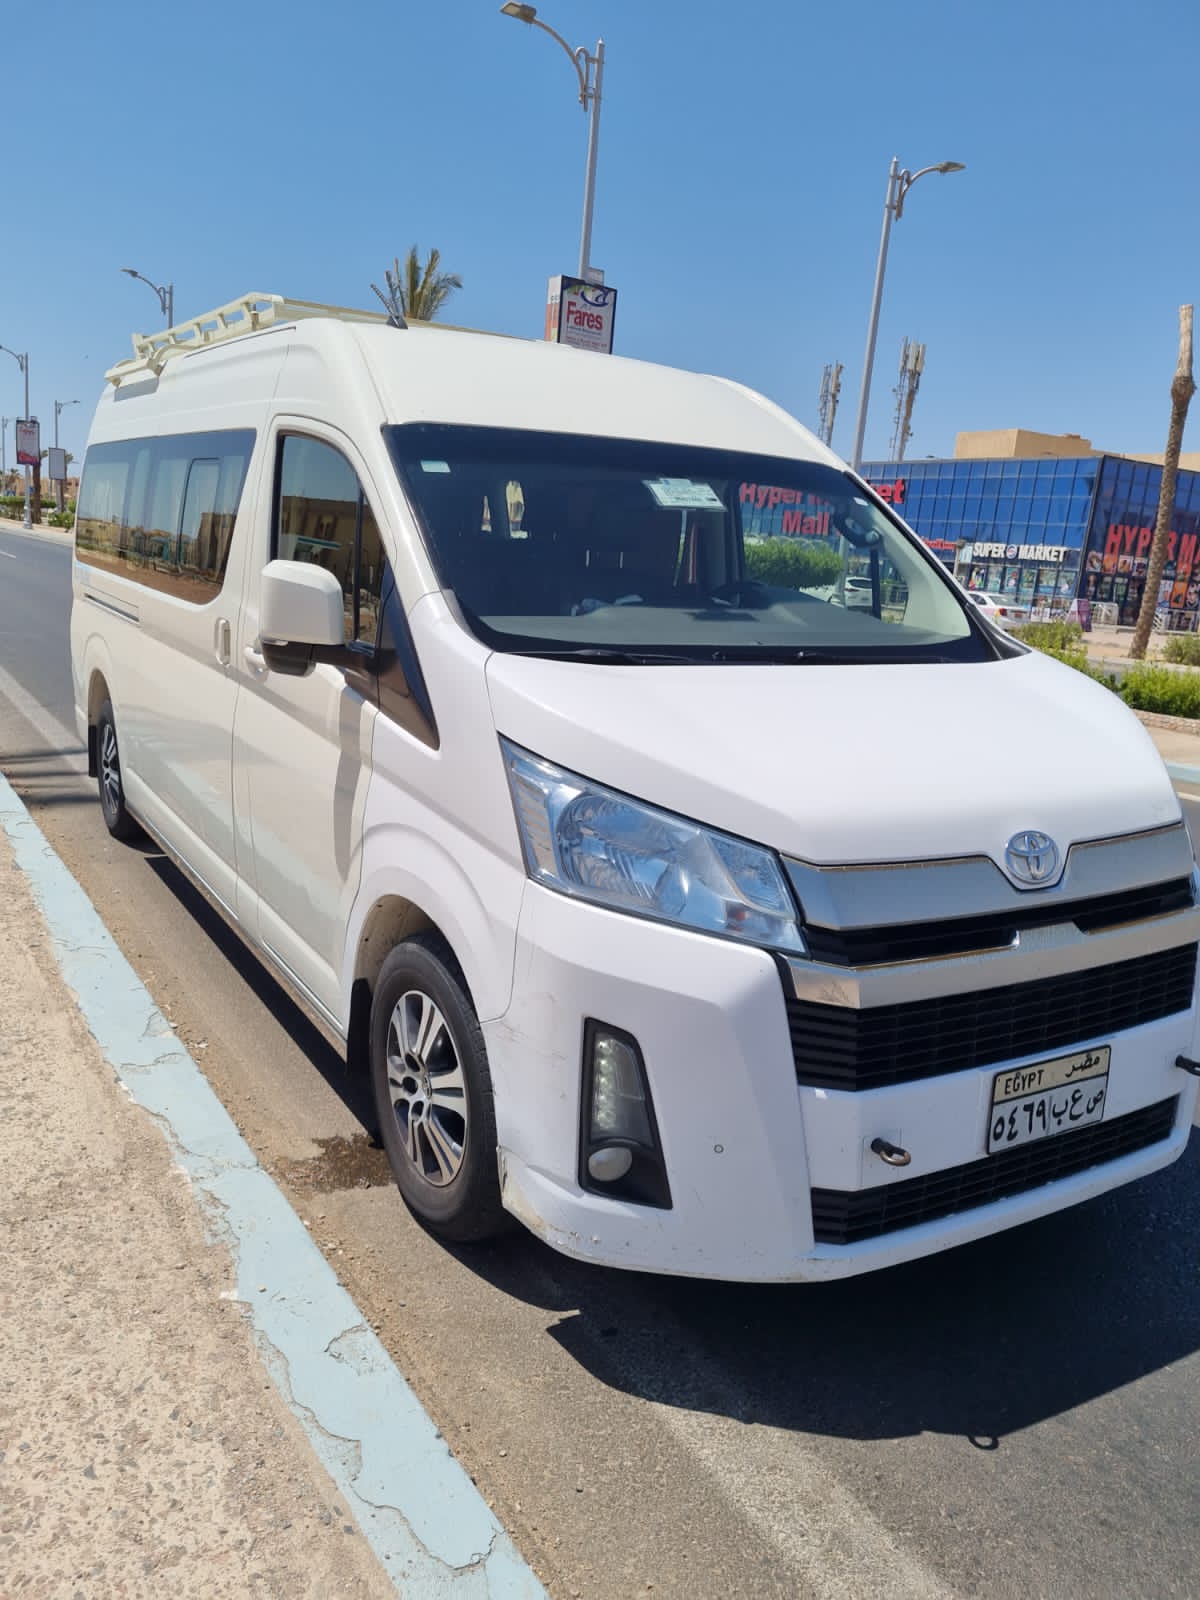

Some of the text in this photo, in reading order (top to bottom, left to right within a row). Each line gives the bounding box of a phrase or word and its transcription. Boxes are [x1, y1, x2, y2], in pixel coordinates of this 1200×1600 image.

[566, 300, 603, 331] Fares
[739, 482, 803, 509] Hyper
[782, 510, 830, 536] Mall
[973, 542, 1006, 559] SUPER
[1018, 544, 1067, 562] MARKET
[1104, 524, 1178, 561] HYPR
[1065, 1053, 1100, 1078] مصر
[1004, 1069, 1044, 1095] EGYPT
